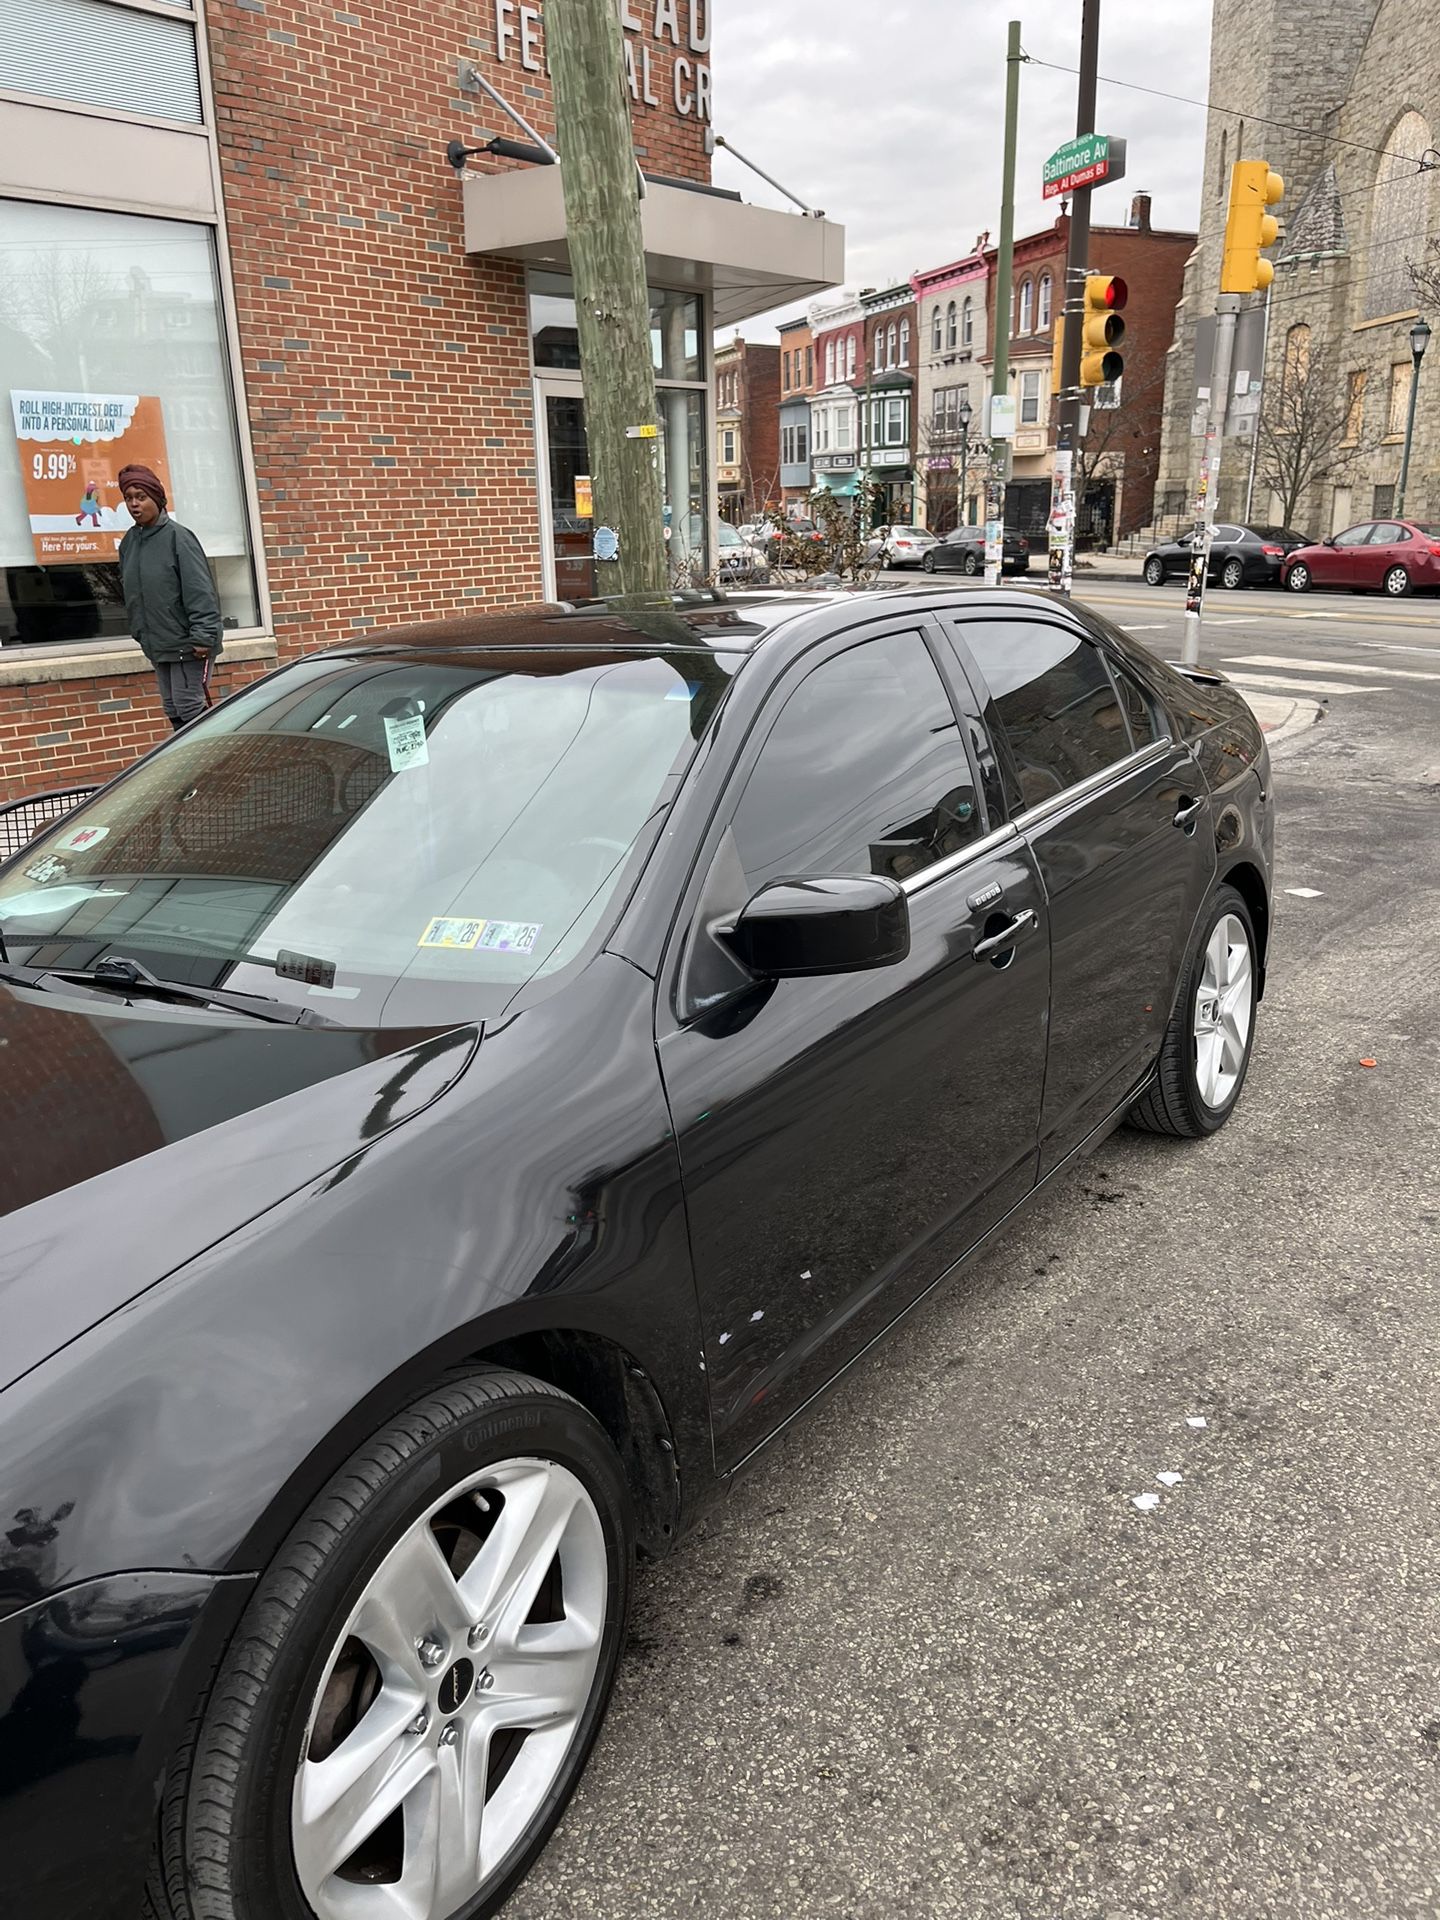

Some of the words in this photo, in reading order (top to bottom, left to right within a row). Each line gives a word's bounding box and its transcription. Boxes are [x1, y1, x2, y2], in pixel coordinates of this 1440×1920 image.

[674, 56, 713, 120] CR
[1044, 149, 1090, 181] Baltimore
[1093, 142, 1107, 160] Av
[19, 400, 40, 415] ROLL
[42, 400, 102, 417] HIGH-INTEREST
[103, 403, 124, 417] DEBT
[22, 416, 41, 430] INTO
[43, 416, 50, 430] A
[51, 417, 92, 431] PERSONAL
[94, 418, 115, 432] LOAN
[33, 453, 77, 480] 9.99%
[42, 541, 61, 552] Here
[63, 540, 75, 551] for
[460, 922, 480, 943] 26
[516, 926, 537, 948] 26
[463, 1408, 541, 1452] Continental
